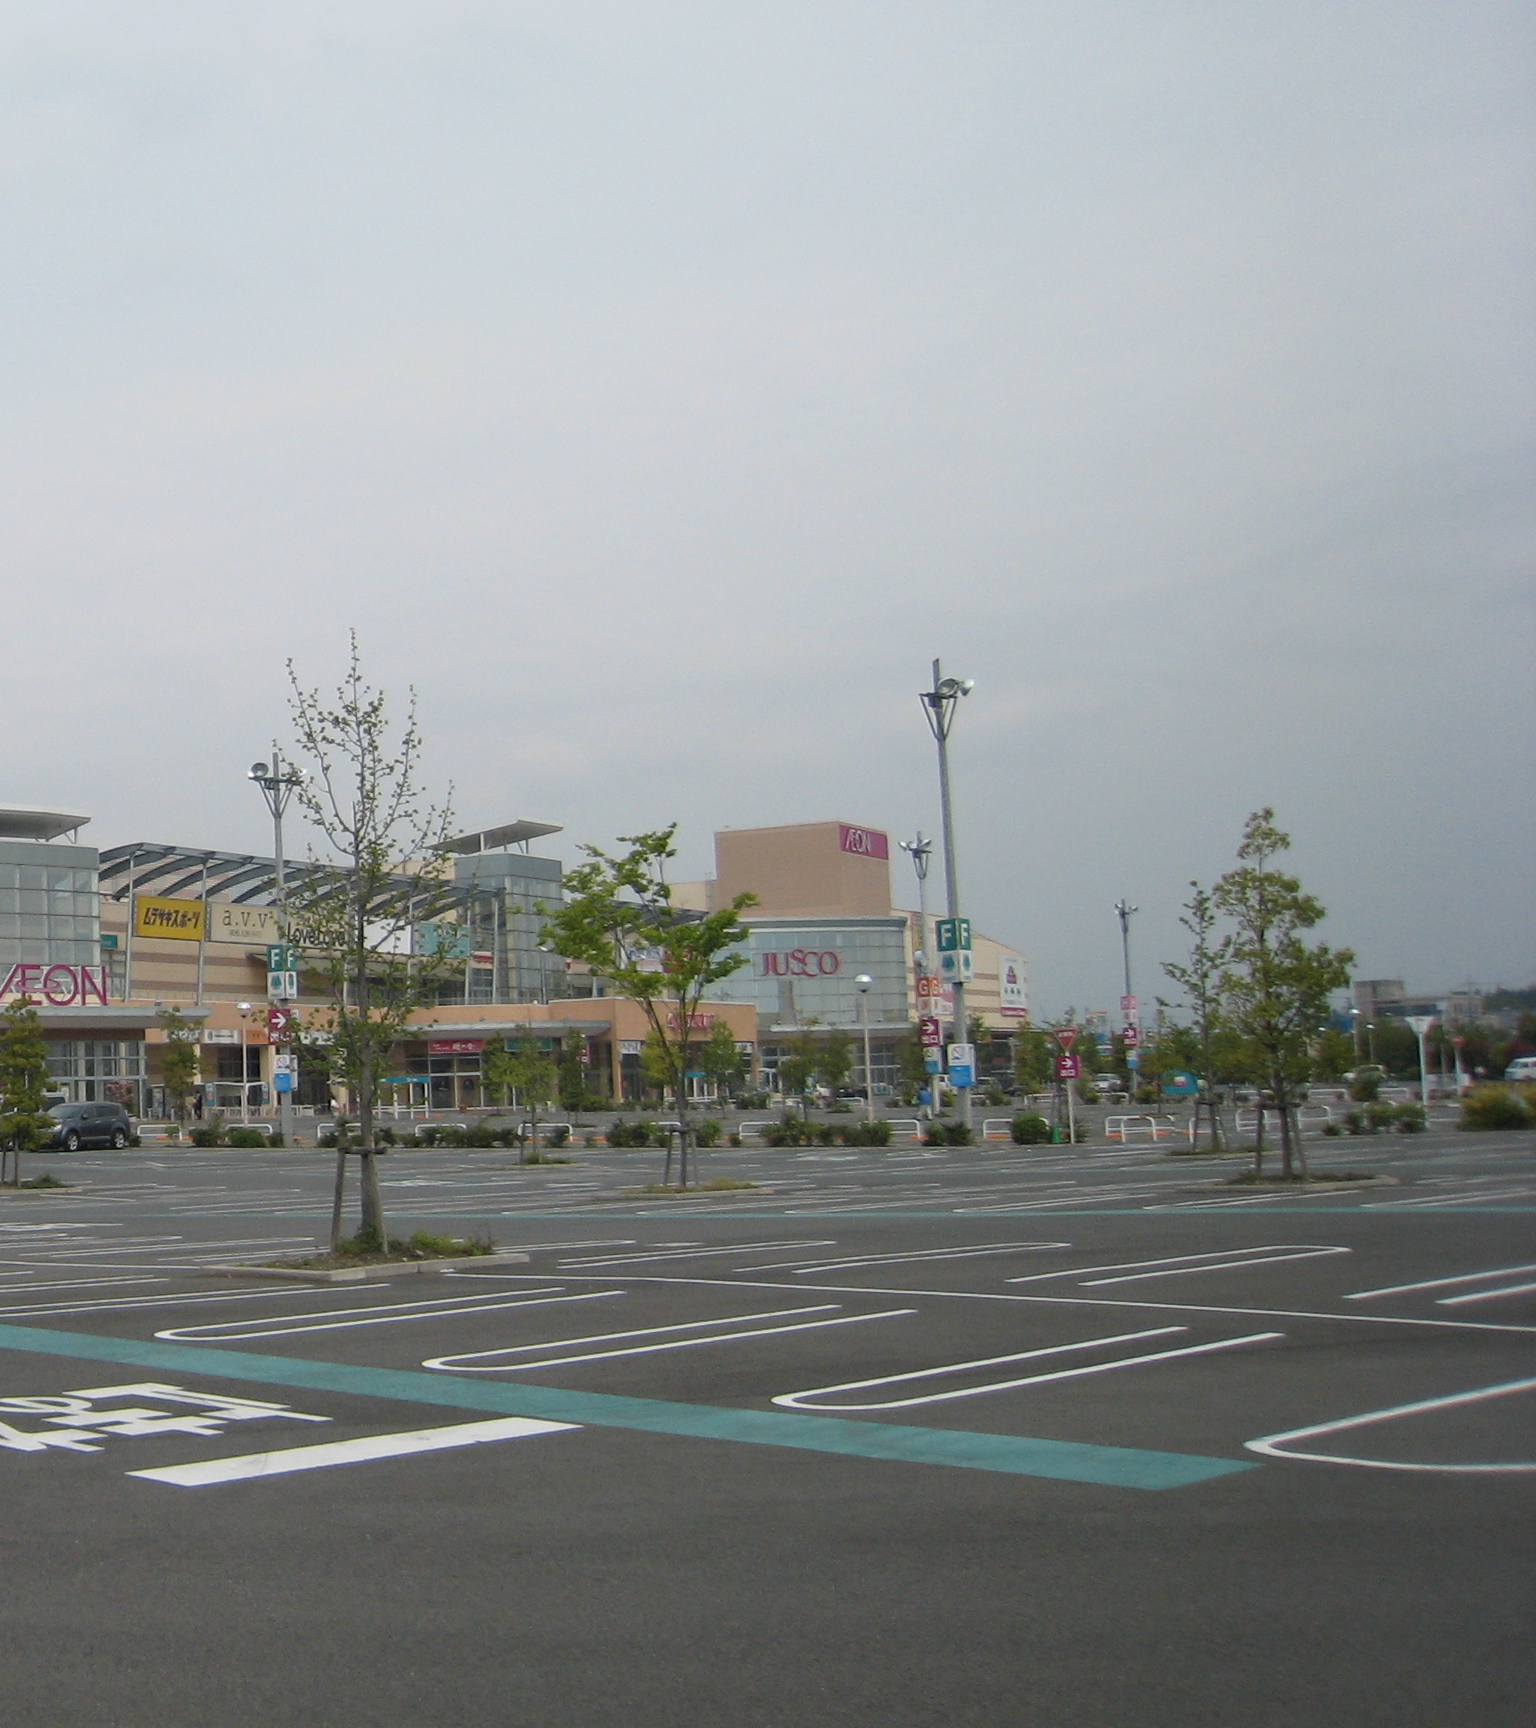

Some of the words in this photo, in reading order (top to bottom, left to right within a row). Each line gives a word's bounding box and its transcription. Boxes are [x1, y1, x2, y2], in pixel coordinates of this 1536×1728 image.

[142, 906, 201, 930] ムラサキスポーツ
[940, 923, 953, 947] F
[960, 922, 970, 947] F
[270, 948, 281, 969] F
[761, 948, 840, 978] JUSCO
[917, 979, 929, 995] G
[920, 1034, 939, 1044] 出口
